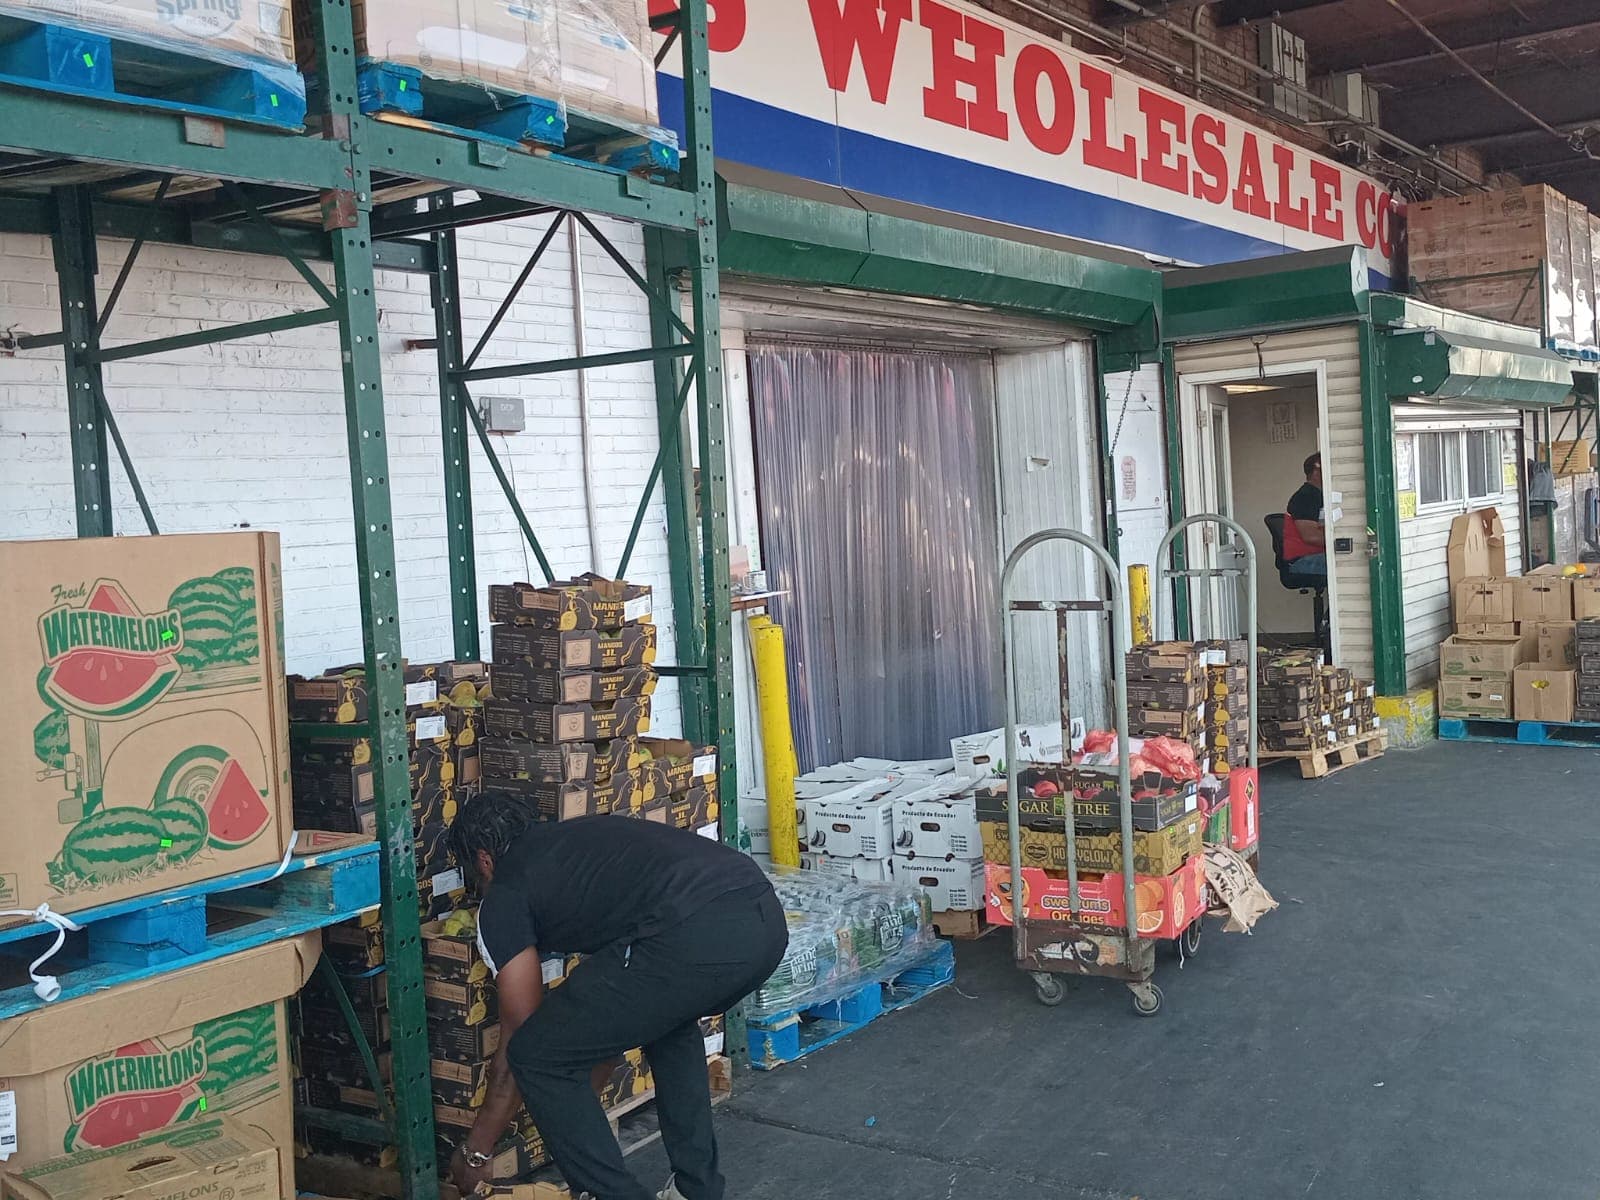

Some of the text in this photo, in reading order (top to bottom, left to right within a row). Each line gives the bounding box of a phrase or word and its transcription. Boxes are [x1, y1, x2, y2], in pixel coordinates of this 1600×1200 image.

[806, 0, 1344, 242] WHOLESALE
[50, 581, 86, 604] Fresh
[43, 608, 180, 660] WATERMELONS
[1002, 800, 1113, 815] SGAR TREE
[1053, 846, 1110, 863] HOYGLOW
[1043, 897, 1108, 911] sweums
[69, 1039, 204, 1116] WATERMELONS
